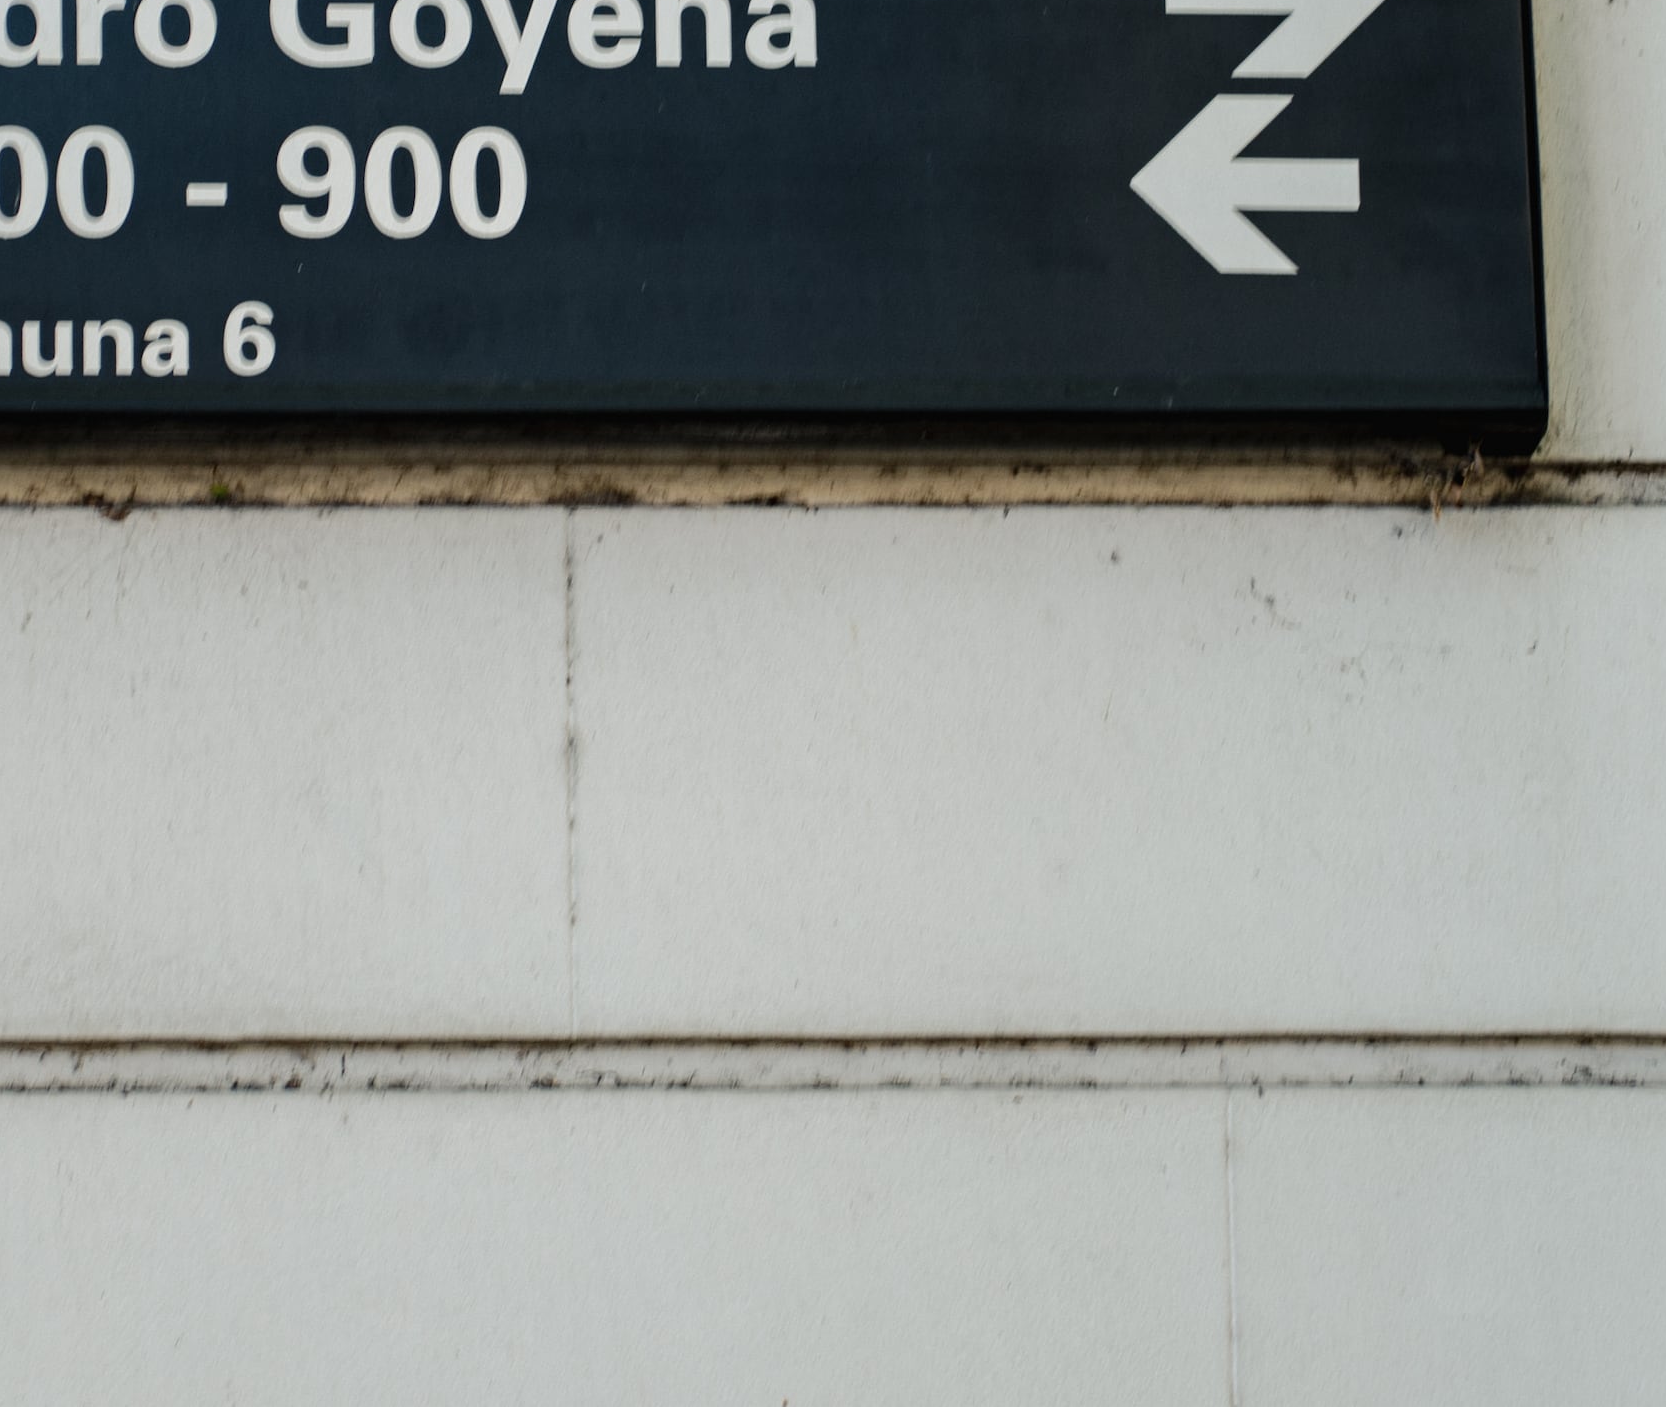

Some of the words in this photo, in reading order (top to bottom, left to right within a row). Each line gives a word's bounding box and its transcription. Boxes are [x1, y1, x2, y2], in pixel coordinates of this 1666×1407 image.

[185, 181, 229, 207] -
[276, 125, 528, 240] 900
[222, 300, 276, 377] 6
